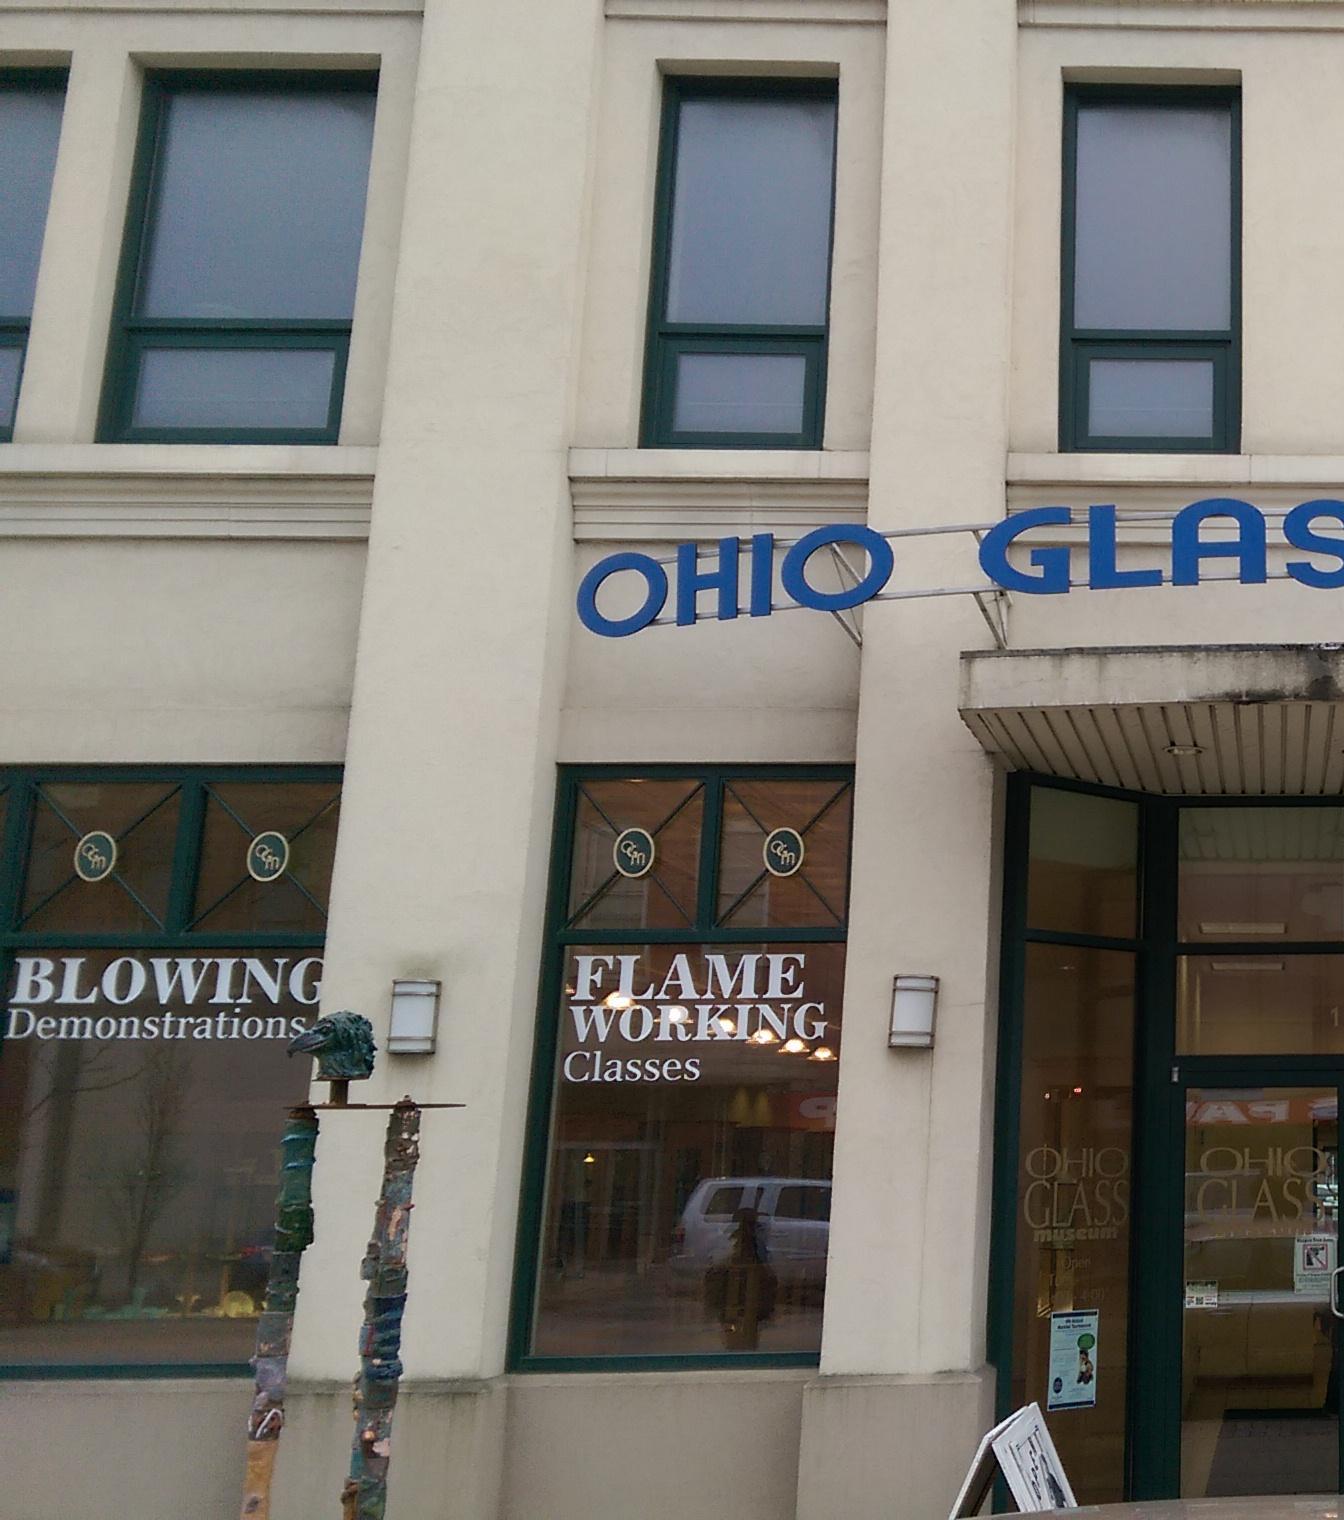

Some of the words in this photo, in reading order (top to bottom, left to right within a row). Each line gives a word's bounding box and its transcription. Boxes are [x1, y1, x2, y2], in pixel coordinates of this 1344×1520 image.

[577, 524, 894, 638] OHIO
[8, 957, 325, 1005] BLOWING
[570, 953, 805, 1000] FLAME
[3, 1007, 306, 1040] Demonstrations
[569, 1002, 828, 1043] WORKING
[563, 1050, 700, 1082] Classes
[1025, 1147, 1130, 1178] OHIO
[1200, 1146, 1328, 1177] OHIO
[1023, 1180, 1130, 1228] GLASS
